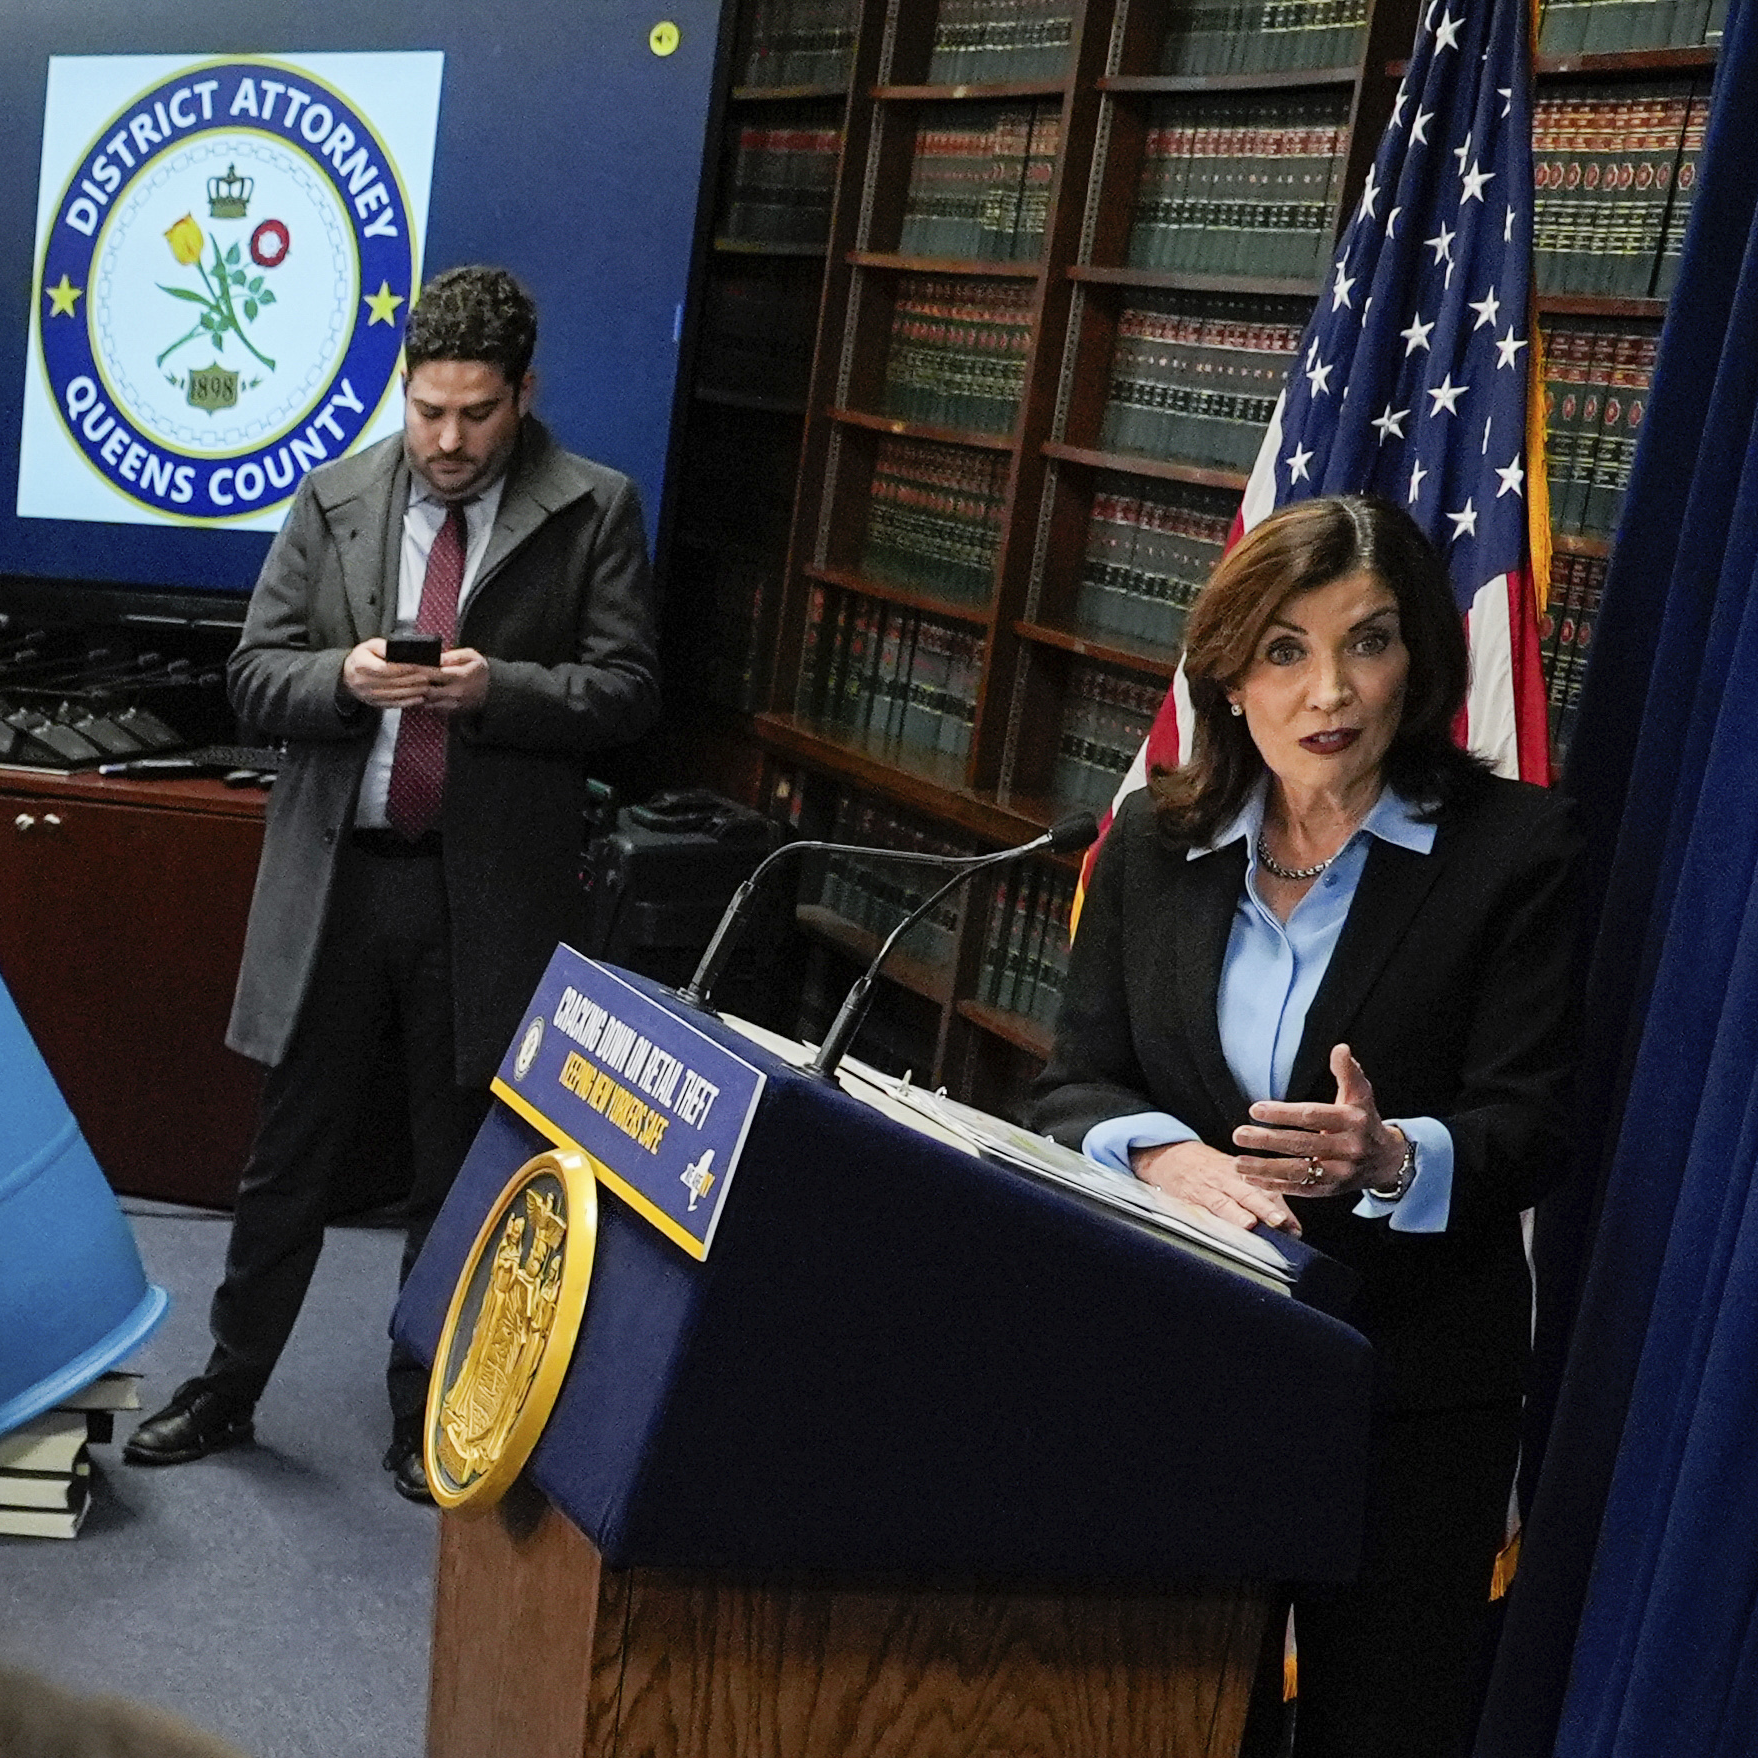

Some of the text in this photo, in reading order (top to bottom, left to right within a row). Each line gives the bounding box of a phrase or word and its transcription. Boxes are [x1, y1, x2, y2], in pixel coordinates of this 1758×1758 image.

[65, 77, 399, 241] DISTRICT ATTORNEY
[65, 375, 365, 505] QUEENS COUNTY
[553, 985, 721, 1131] CRACKING DOWN ON RETAIL THEFT
